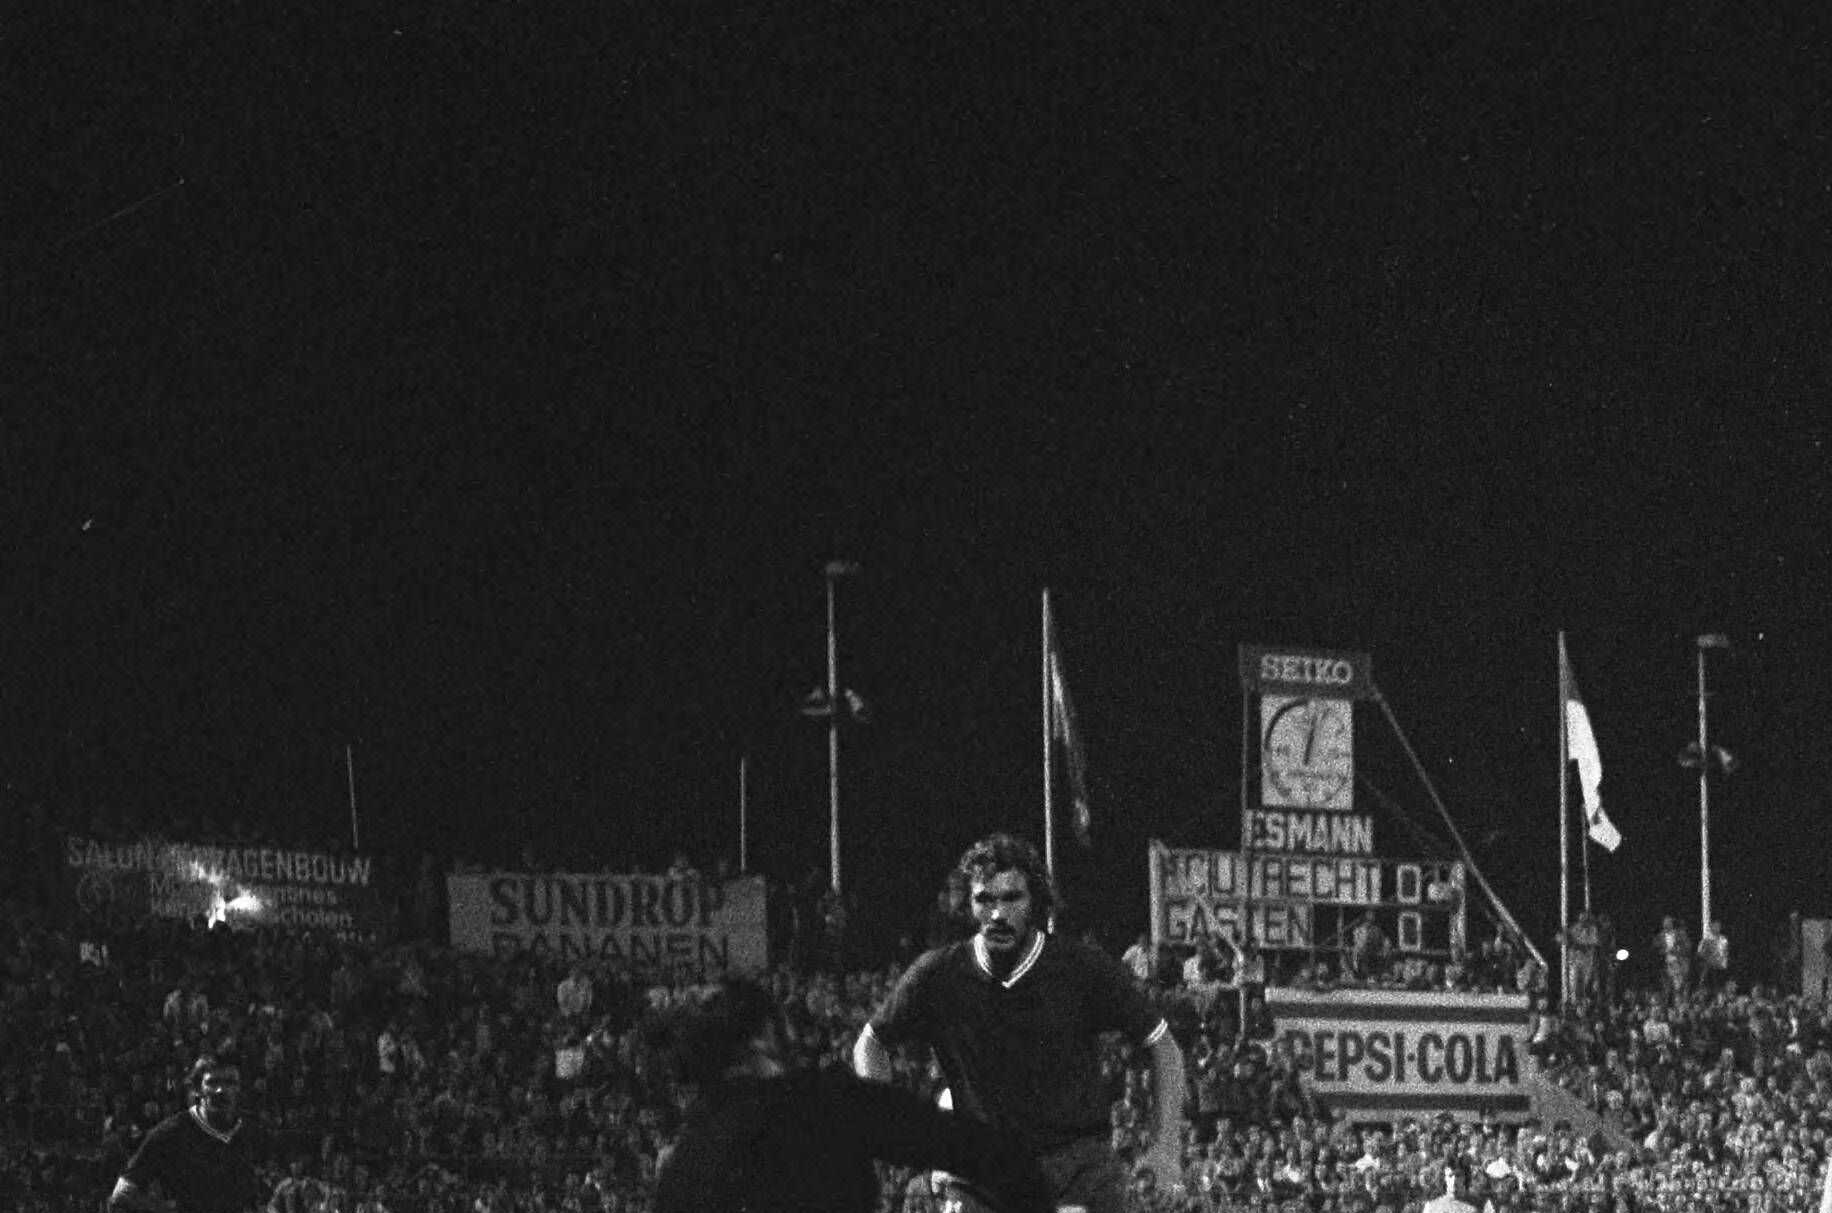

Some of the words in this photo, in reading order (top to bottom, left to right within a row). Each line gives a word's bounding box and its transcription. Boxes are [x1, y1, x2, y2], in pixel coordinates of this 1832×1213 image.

[1260, 653, 1353, 684] SEIKO
[490, 876, 725, 928] SUNDROP
[1213, 855, 1378, 902] UTRECHT
